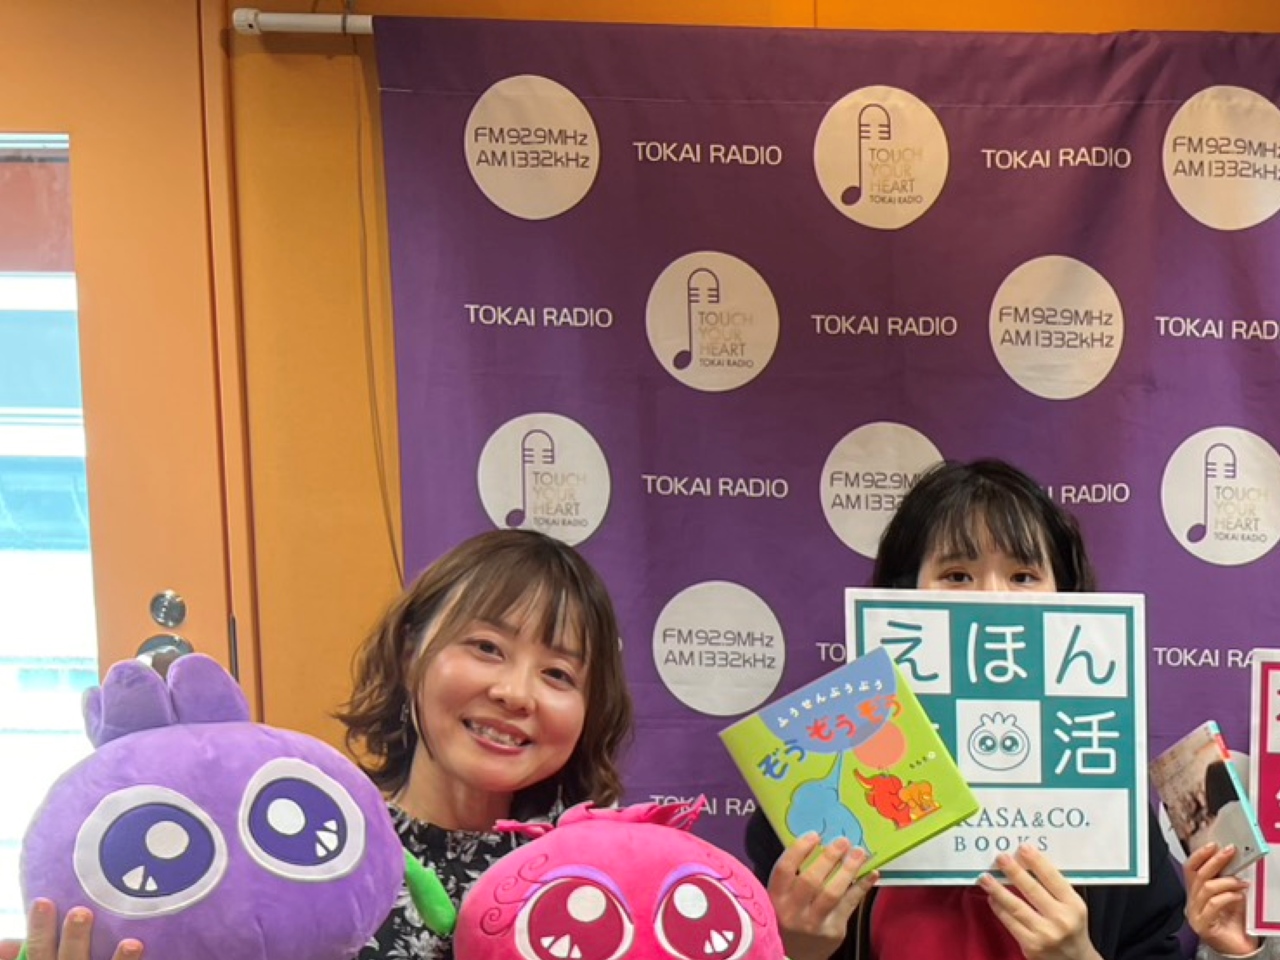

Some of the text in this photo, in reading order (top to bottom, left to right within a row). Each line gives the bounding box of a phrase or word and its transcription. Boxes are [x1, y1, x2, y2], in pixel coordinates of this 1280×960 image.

[633, 141, 782, 165] TOKAI RADIO
[981, 146, 1131, 169] TOKAI RADIO
[870, 179, 914, 193] HEART
[464, 304, 613, 328] TOKAI RADIO
[811, 314, 958, 336] TOKAI RADIO
[1155, 316, 1223, 339] TOKAI
[700, 342, 746, 357] HEART
[642, 474, 789, 498] TOKAI RADIO
[1061, 482, 1131, 504] RADIO
[533, 502, 580, 516] HEART
[1215, 518, 1260, 532] HEART
[1152, 646, 1220, 668] TOKAI
